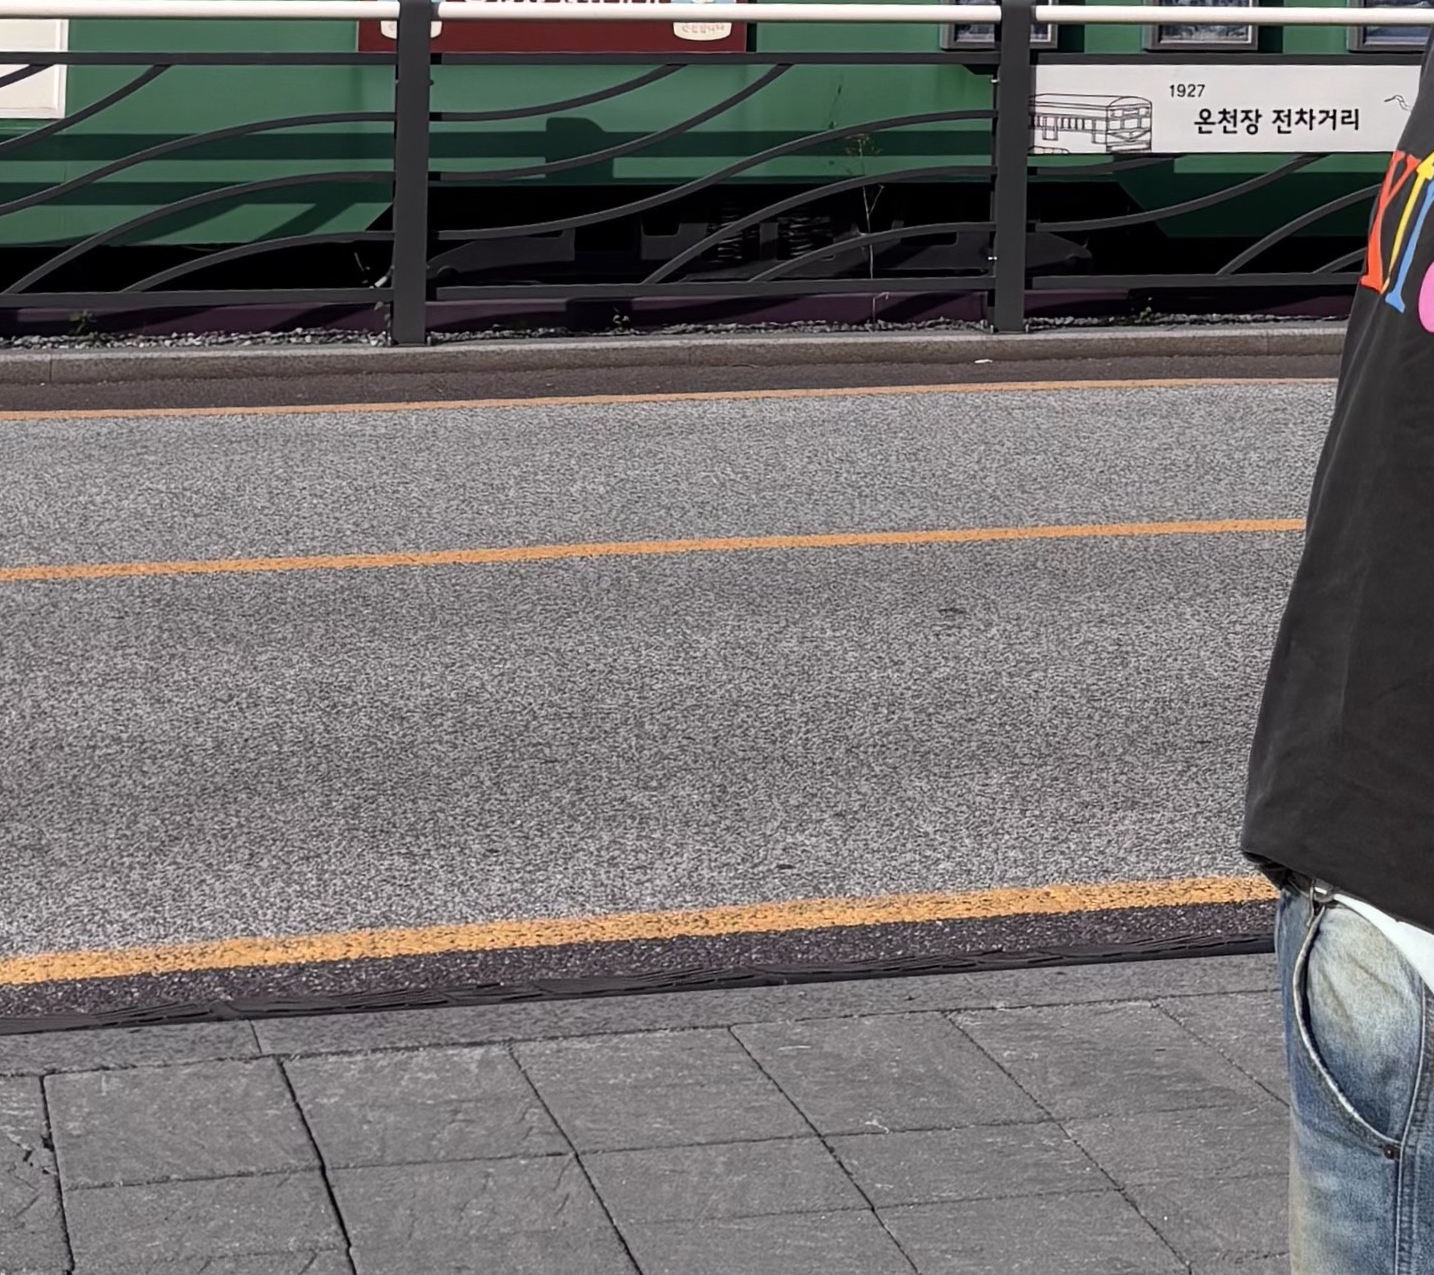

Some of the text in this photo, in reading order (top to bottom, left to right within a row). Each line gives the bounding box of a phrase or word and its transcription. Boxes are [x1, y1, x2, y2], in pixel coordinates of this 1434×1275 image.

[1168, 83, 1206, 99] 1927
[1193, 106, 1360, 136] 온천장 전차거리
